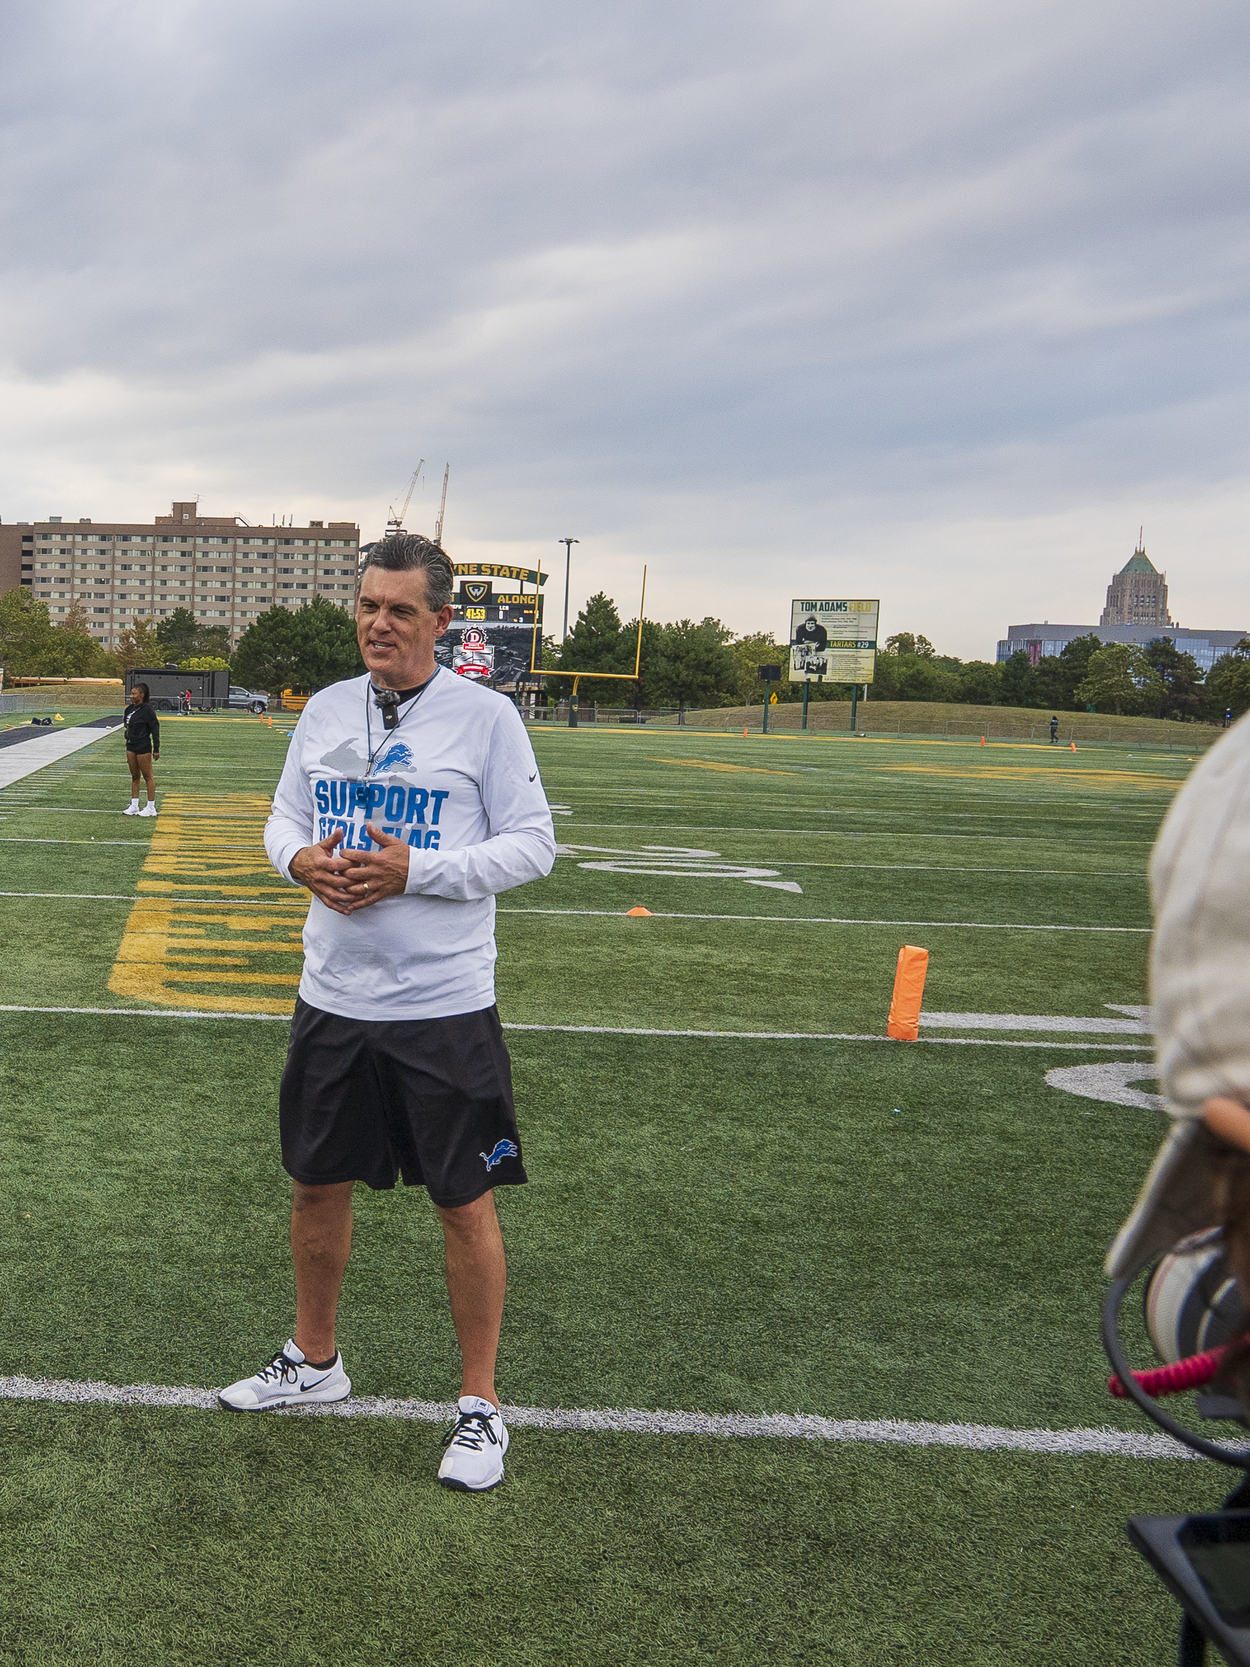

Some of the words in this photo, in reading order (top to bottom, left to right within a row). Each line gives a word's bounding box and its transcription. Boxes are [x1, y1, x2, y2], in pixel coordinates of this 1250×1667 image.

[481, 564, 529, 580] STATE
[497, 595, 535, 604] ALONG
[800, 601, 818, 612] TOM
[818, 601, 848, 612] ADAMS
[848, 601, 872, 612] FIELD
[830, 640, 856, 648] TARTARS
[315, 780, 450, 825] SUPPORT
